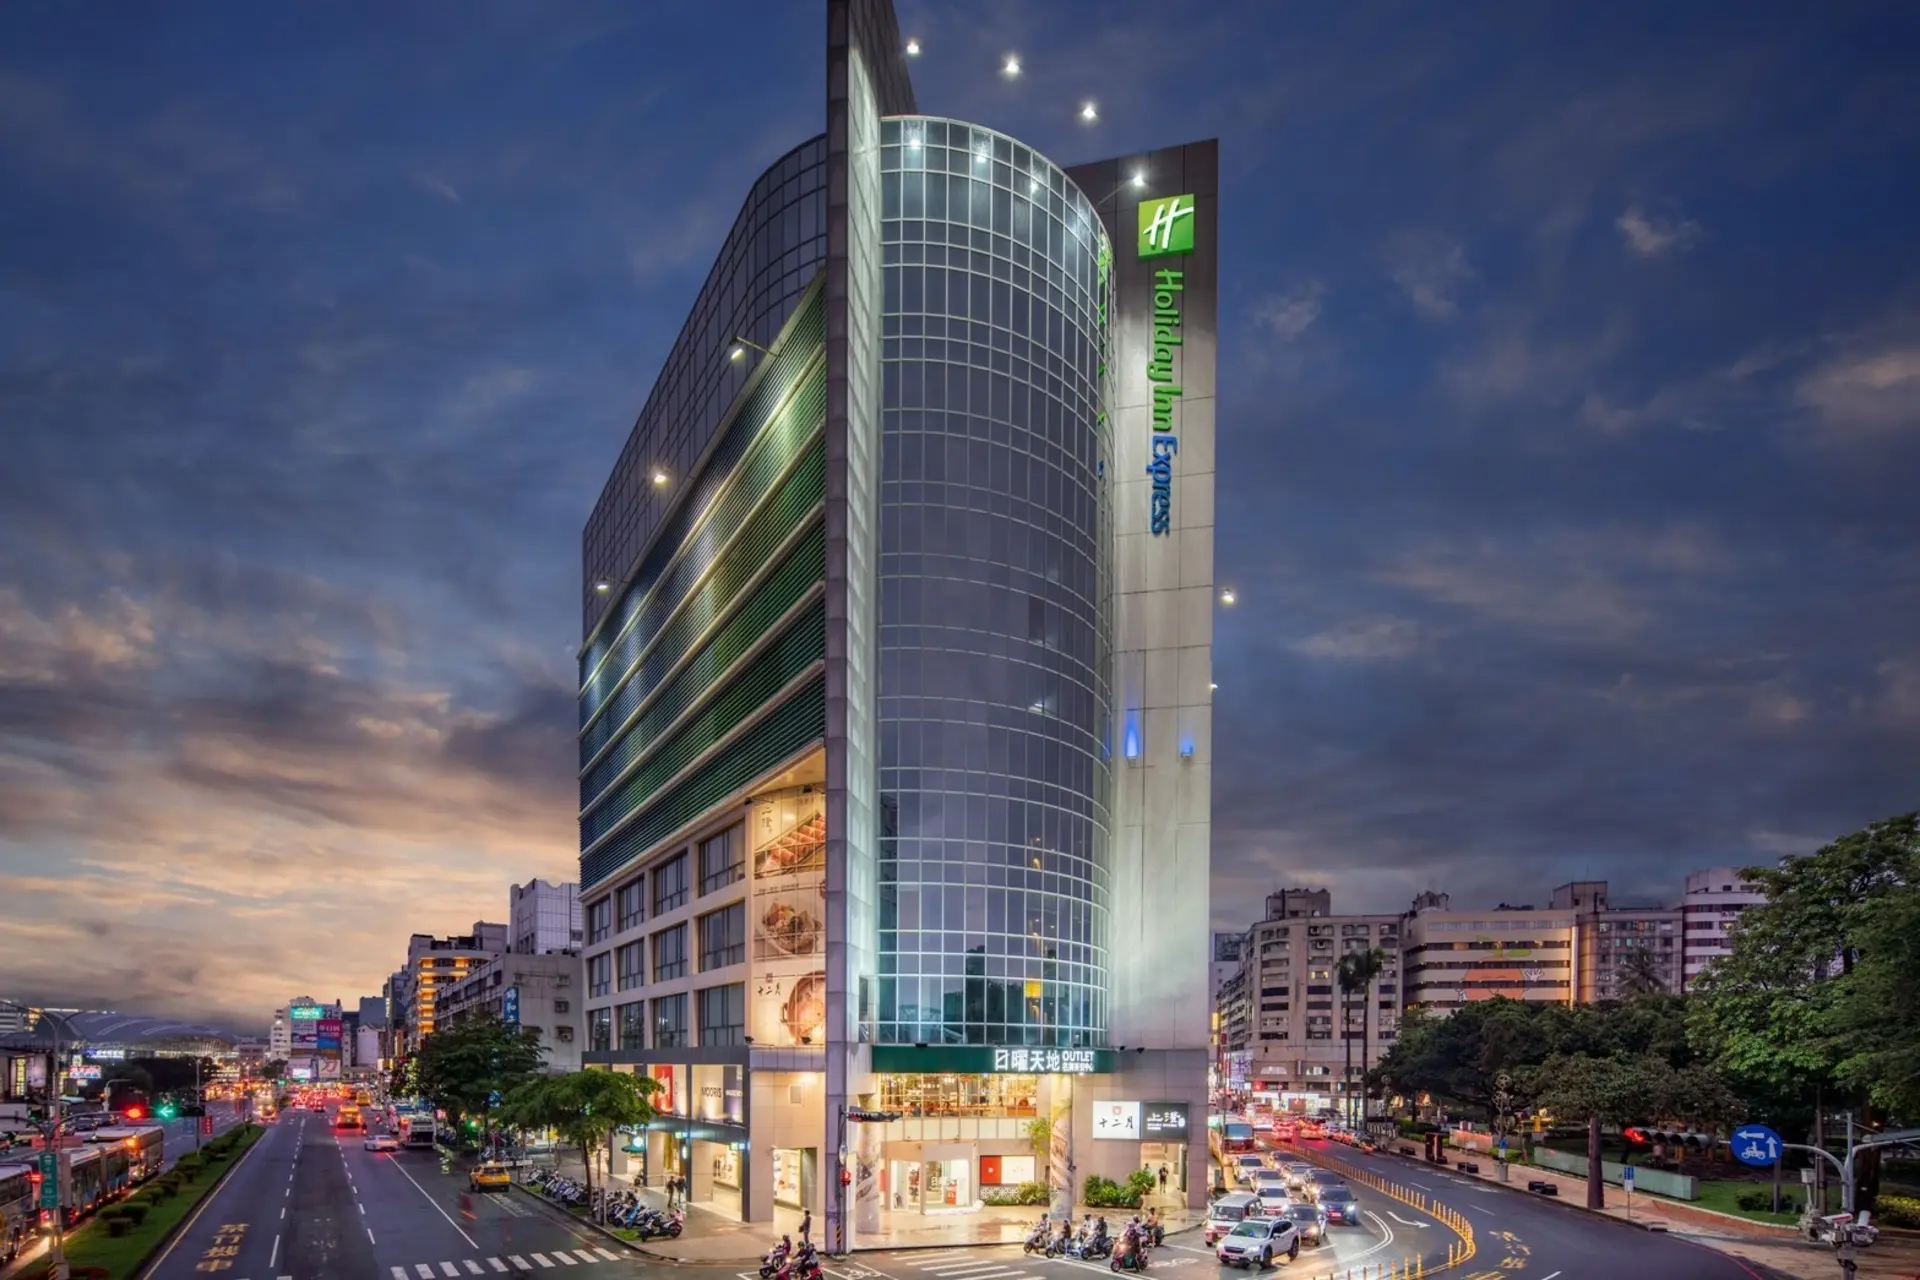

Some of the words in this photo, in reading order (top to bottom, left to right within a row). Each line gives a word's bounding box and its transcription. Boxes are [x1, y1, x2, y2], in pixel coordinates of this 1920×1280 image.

[1147, 269, 1183, 383] Holiday
[1153, 385, 1182, 432] Inn
[1146, 435, 1177, 538] Express
[995, 1049, 1061, 1071] 日曜天地
[1062, 1050, 1095, 1062] OUTLET
[1099, 1116, 1134, 1129] 十二月
